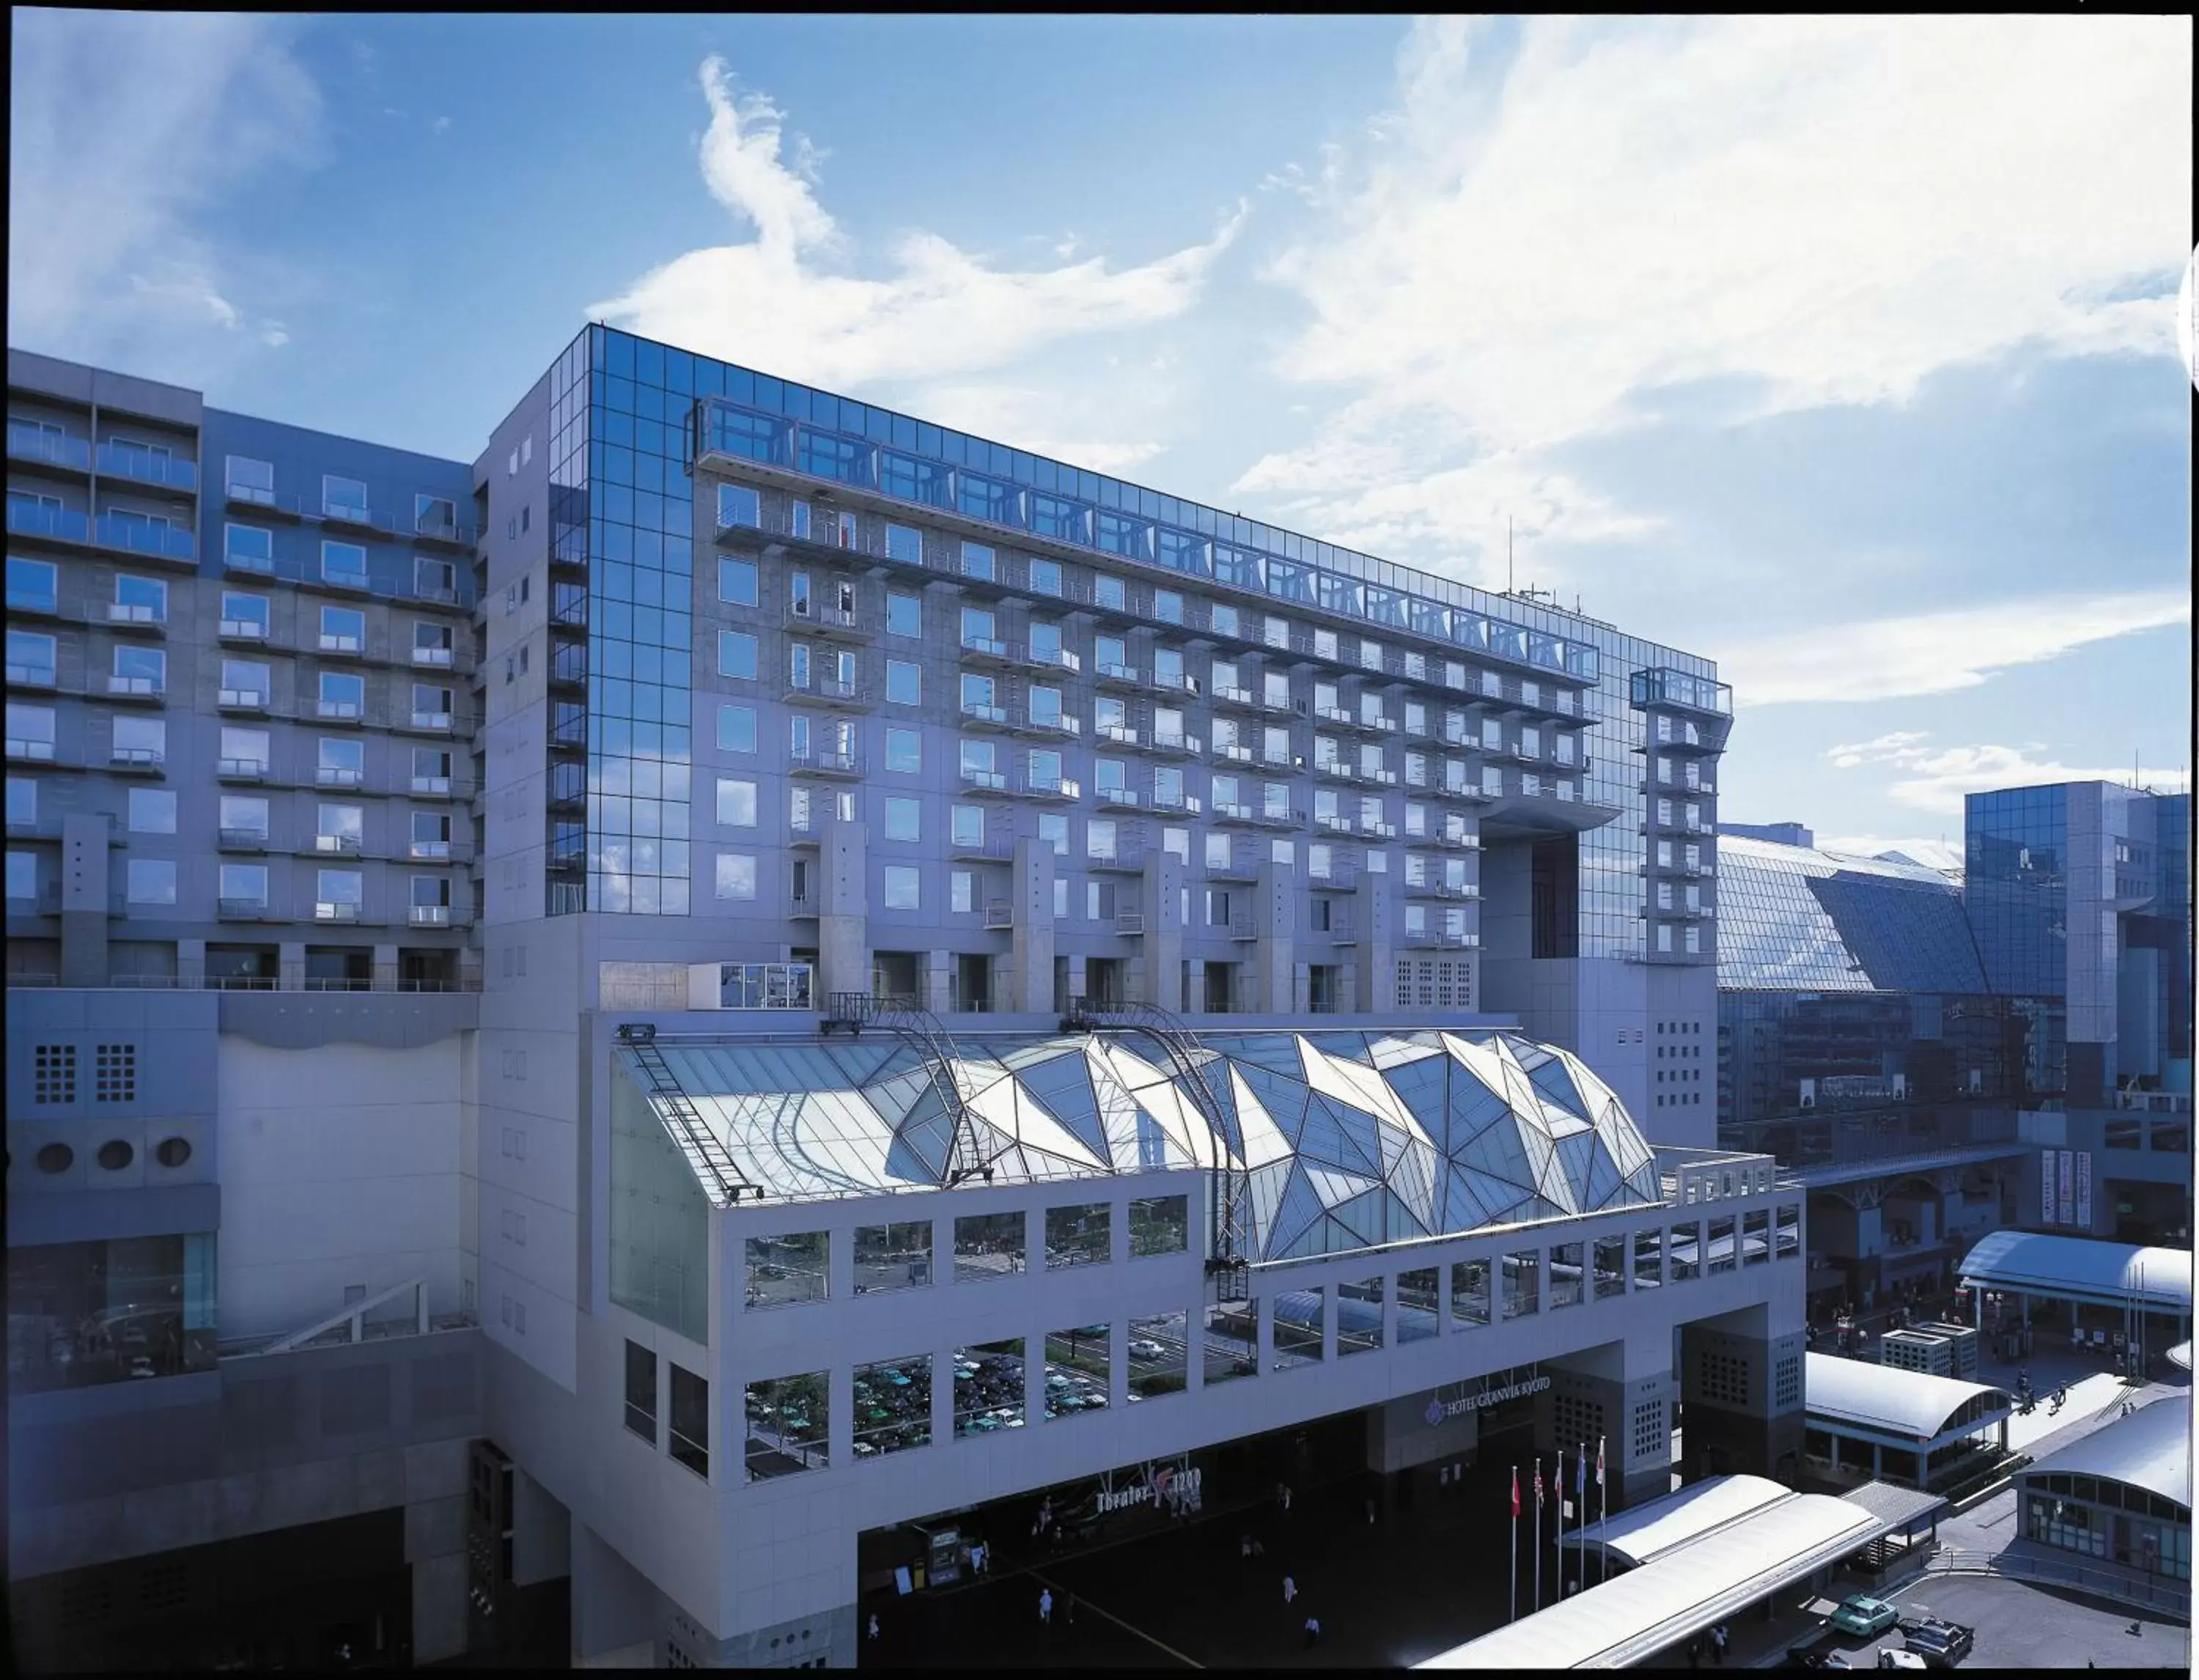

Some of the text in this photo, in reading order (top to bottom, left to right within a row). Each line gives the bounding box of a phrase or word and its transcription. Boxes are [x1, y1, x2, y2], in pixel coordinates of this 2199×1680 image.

[1448, 1376, 1550, 1415] HOTEL GRANVIA KYOTO
[1096, 1484, 1148, 1513] Theater
